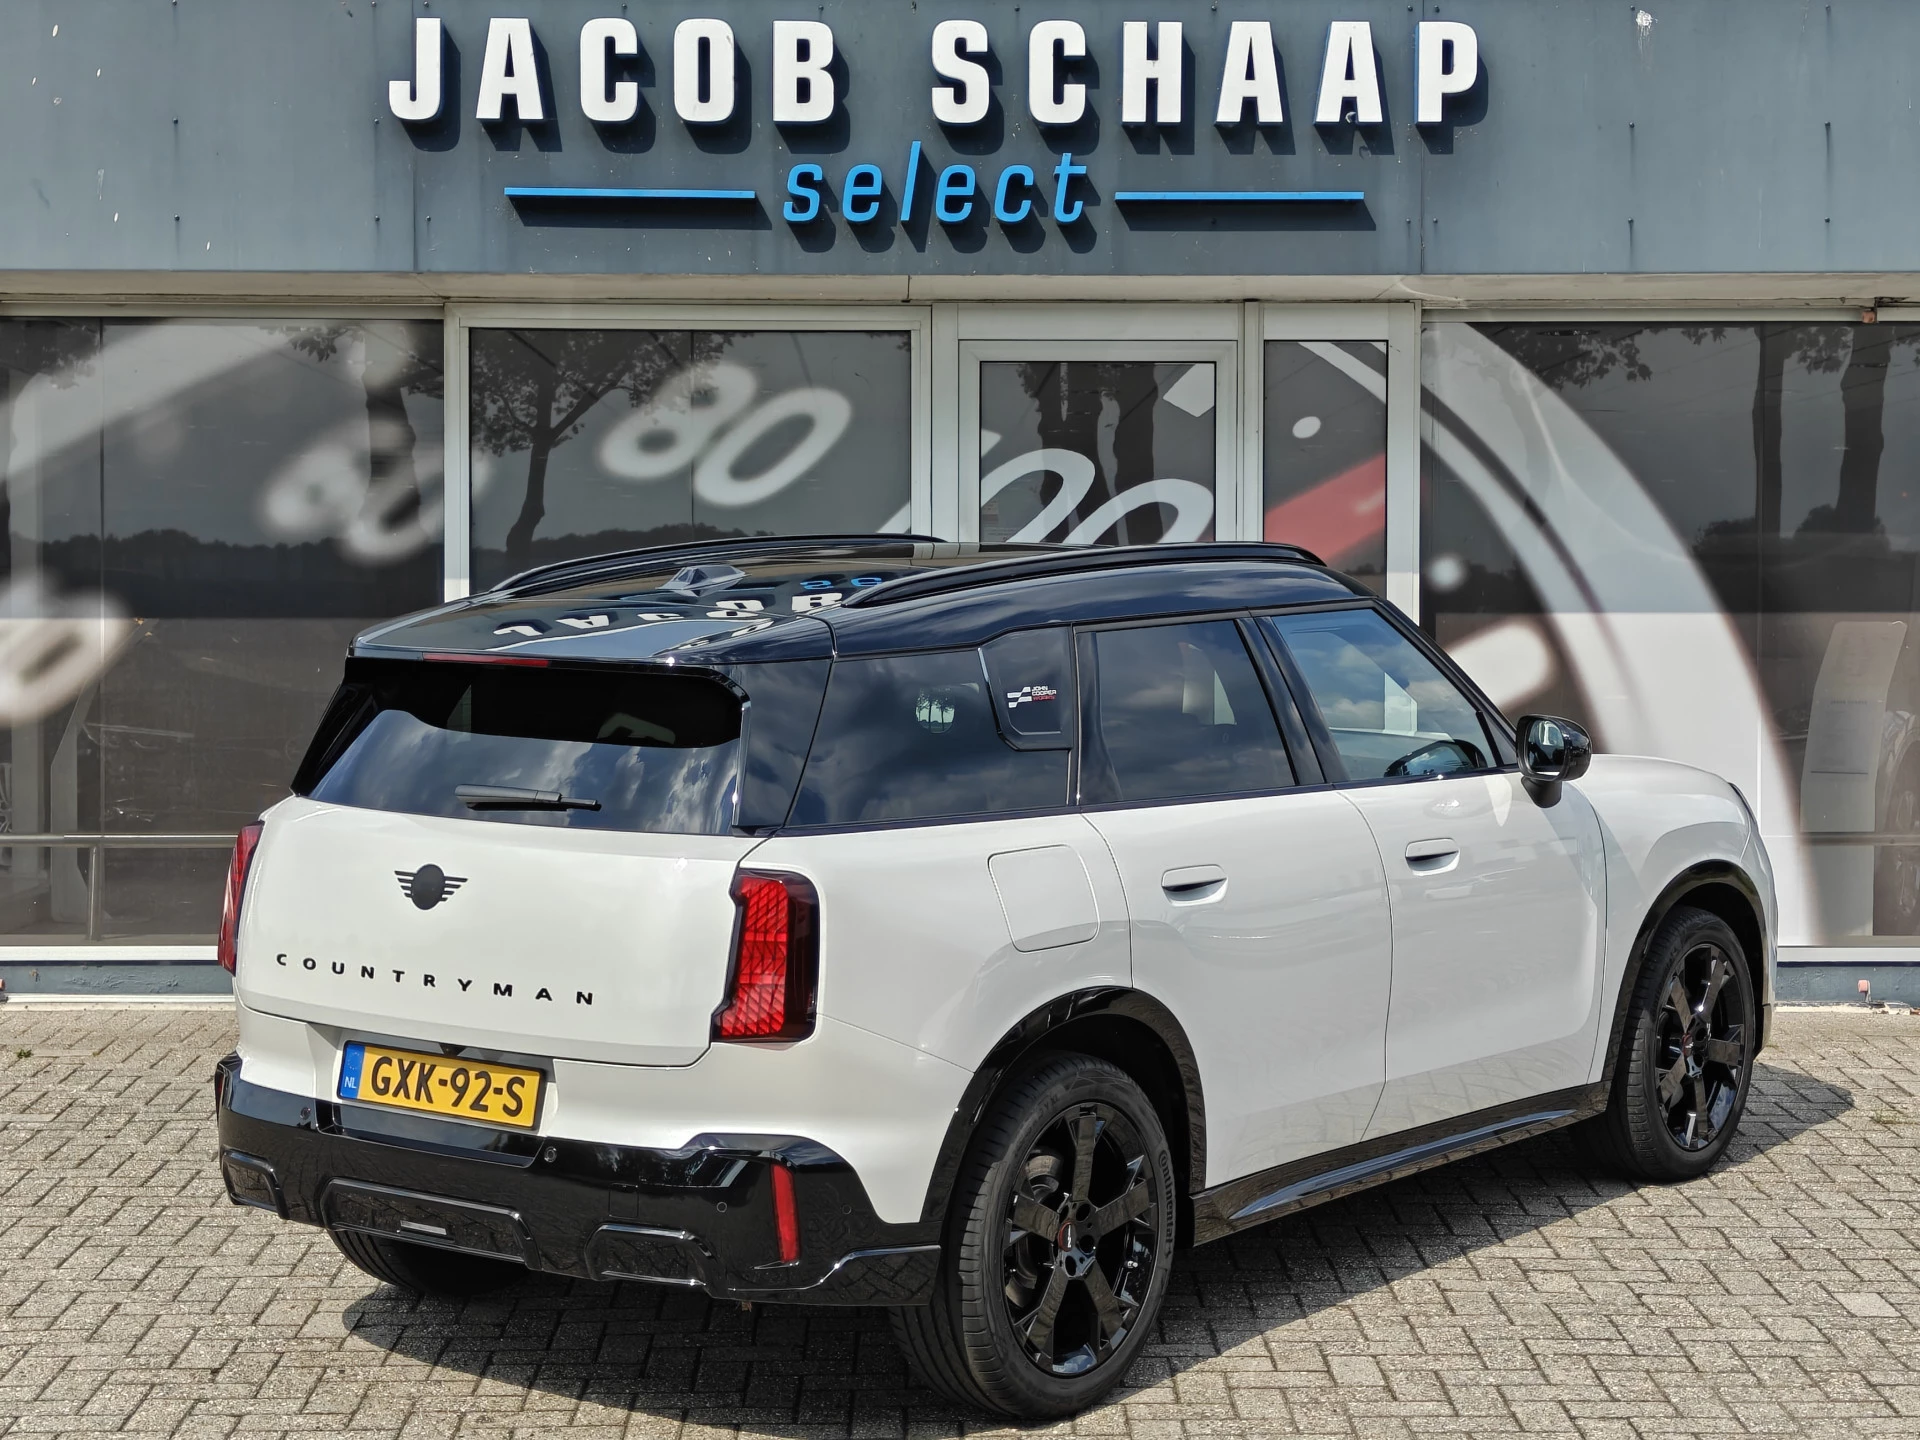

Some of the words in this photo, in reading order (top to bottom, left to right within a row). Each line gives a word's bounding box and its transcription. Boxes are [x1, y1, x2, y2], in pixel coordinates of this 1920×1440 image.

[389, 17, 835, 122] JACOB
[931, 19, 1478, 124] SCHAAP
[783, 140, 1087, 223] select
[276, 953, 593, 1006] COUNTRYMAN
[344, 1076, 357, 1089] NL
[371, 1056, 526, 1118] GXK-92-S
